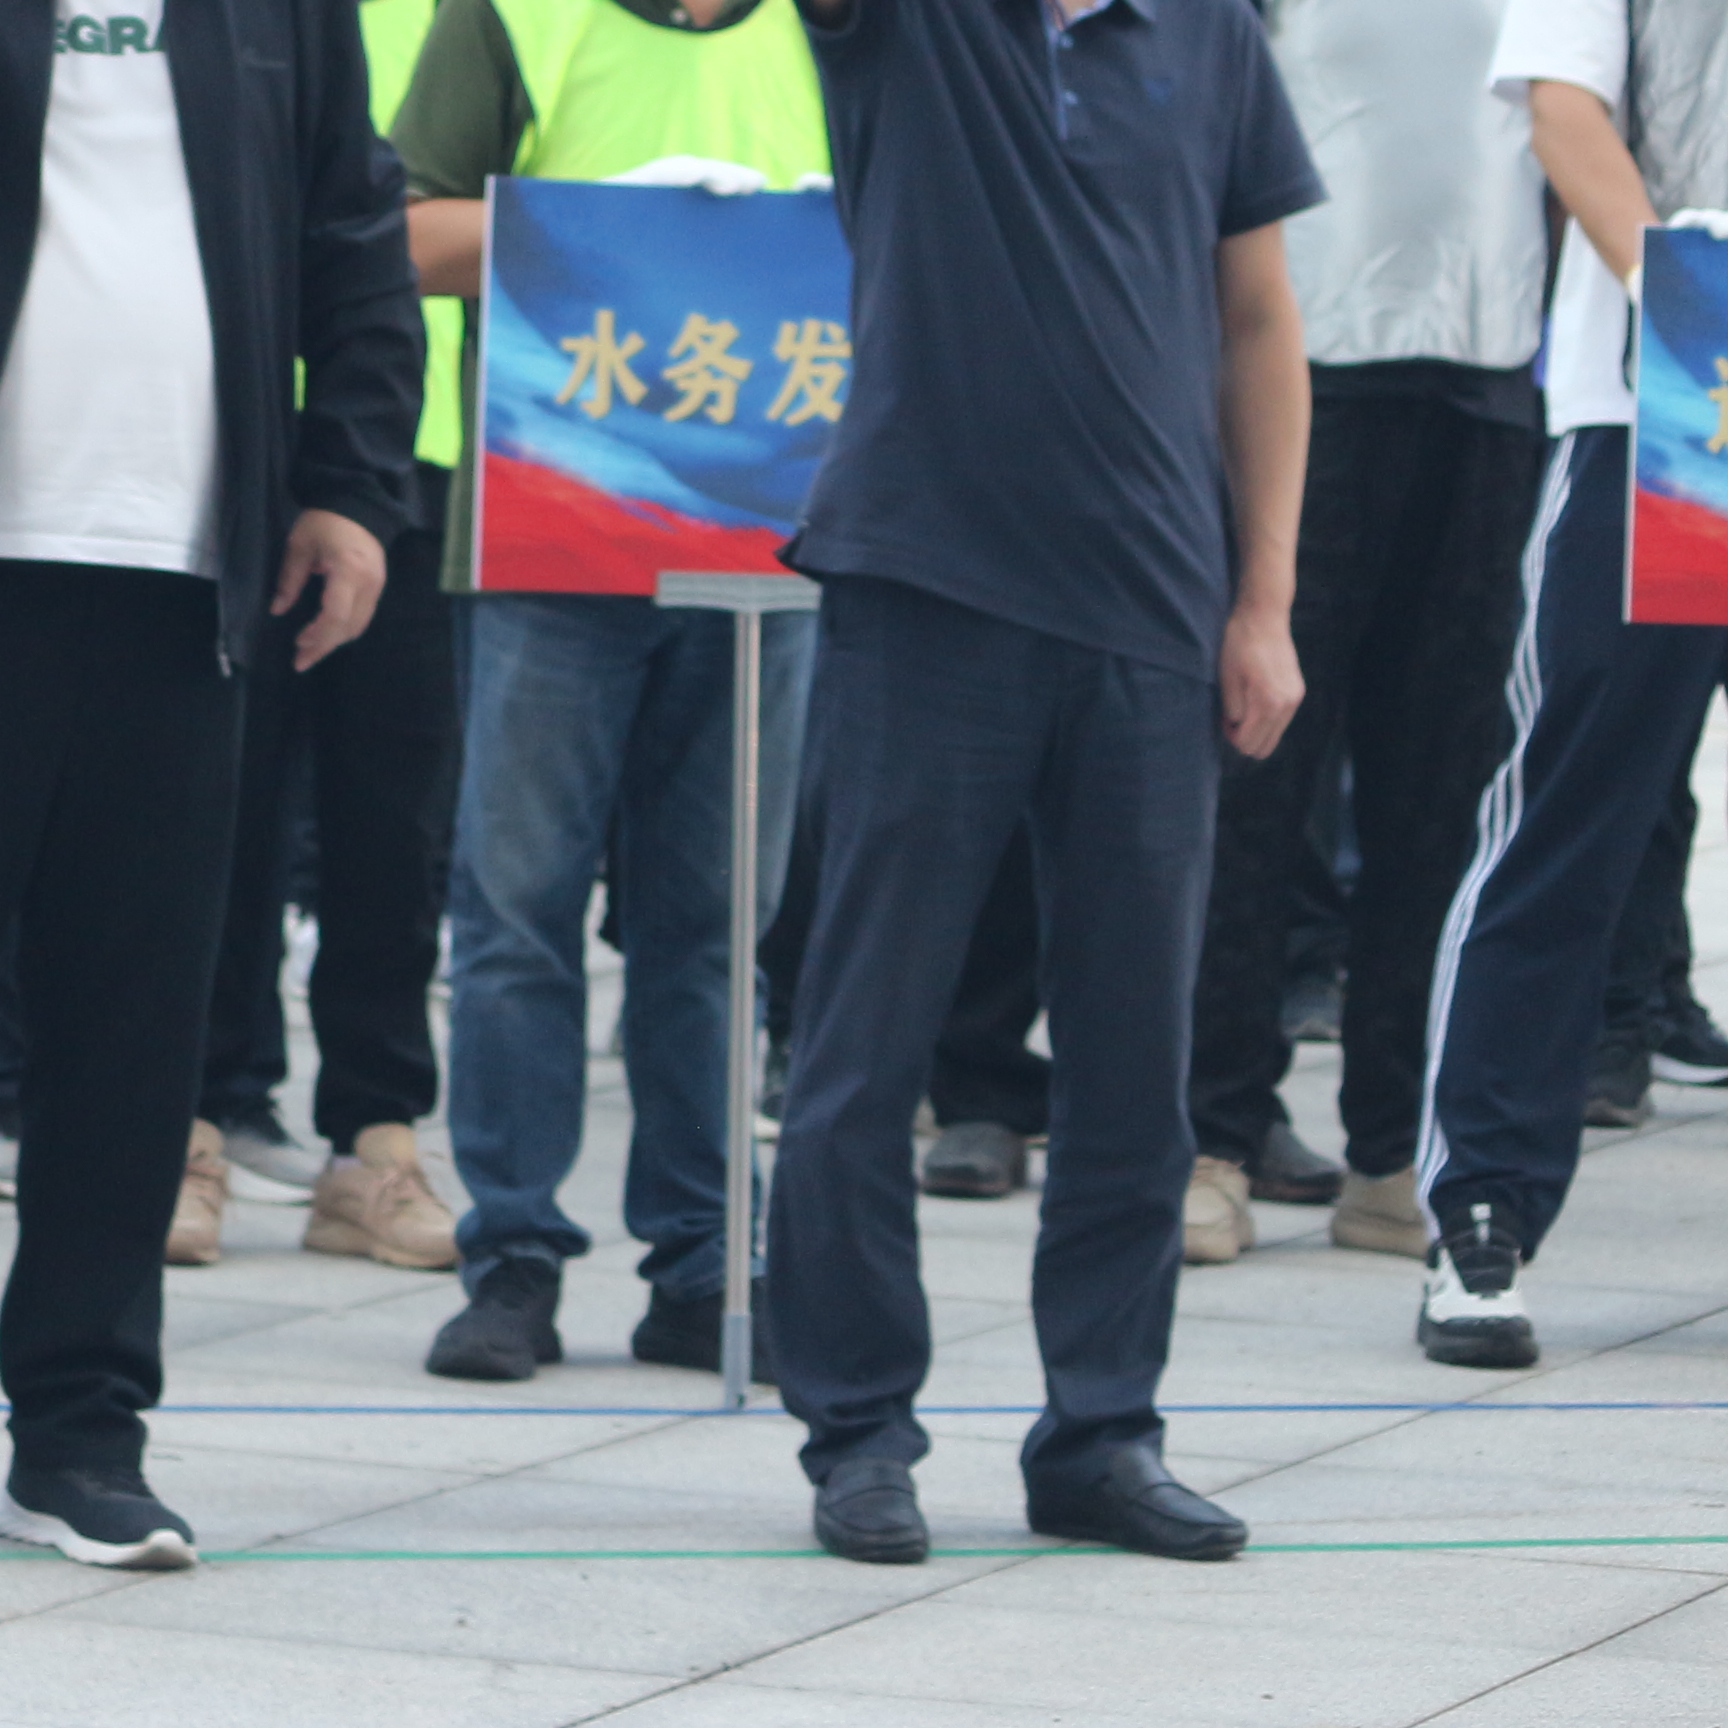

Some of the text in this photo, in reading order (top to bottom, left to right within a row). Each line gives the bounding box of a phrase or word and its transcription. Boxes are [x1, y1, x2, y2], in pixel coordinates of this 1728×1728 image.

[53, 14, 166, 55] GR
[555, 309, 853, 426] 水务发
